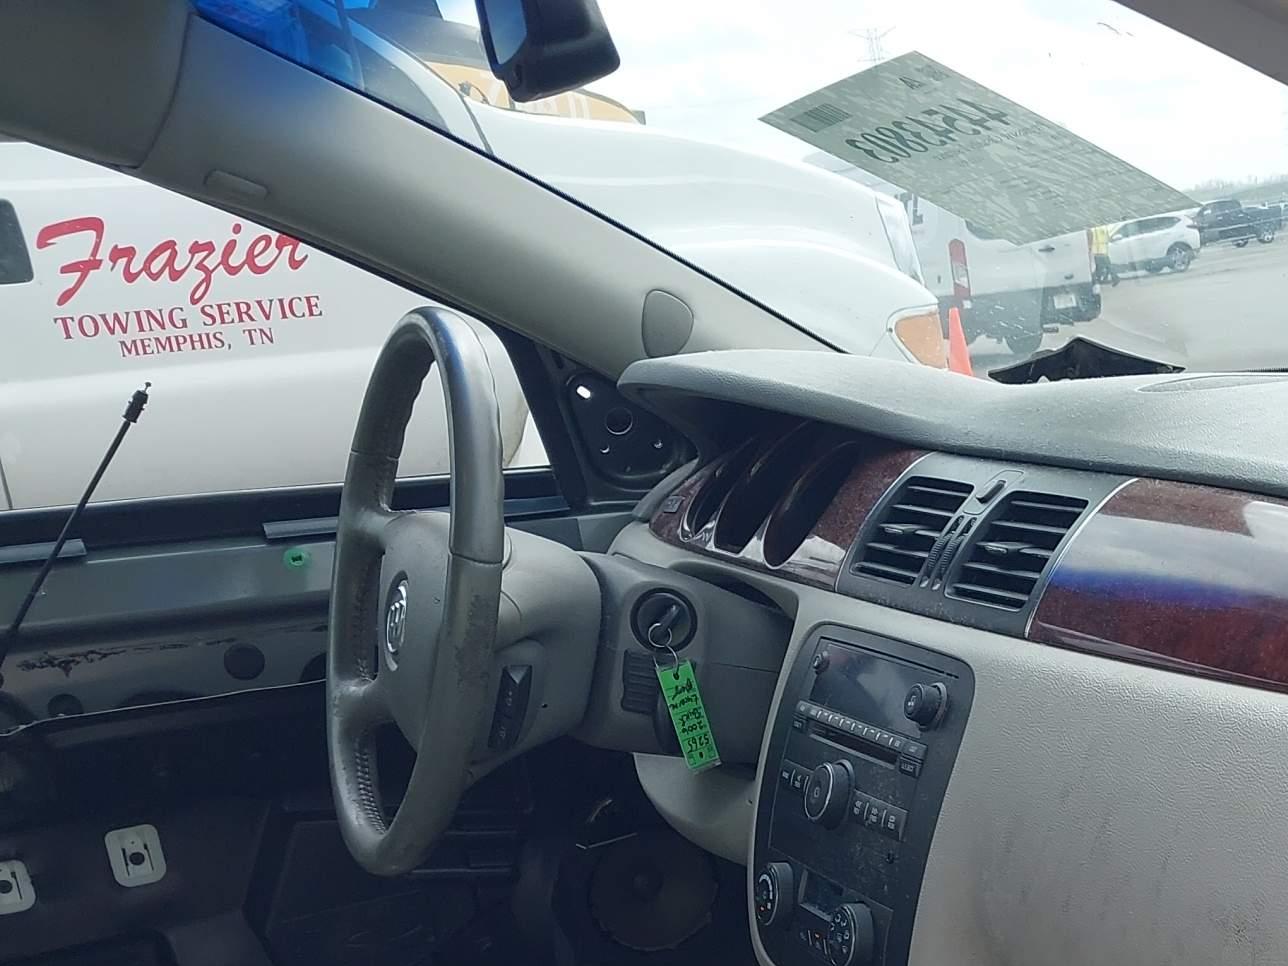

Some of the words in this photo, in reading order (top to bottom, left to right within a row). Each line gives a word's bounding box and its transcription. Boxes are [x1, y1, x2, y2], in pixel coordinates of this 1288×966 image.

[36, 217, 309, 306] Frazier
[54, 307, 188, 340] TOWING
[200, 295, 323, 327] SERVICE
[119, 331, 233, 358] MEMPHIS,
[243, 327, 275, 346] TN
